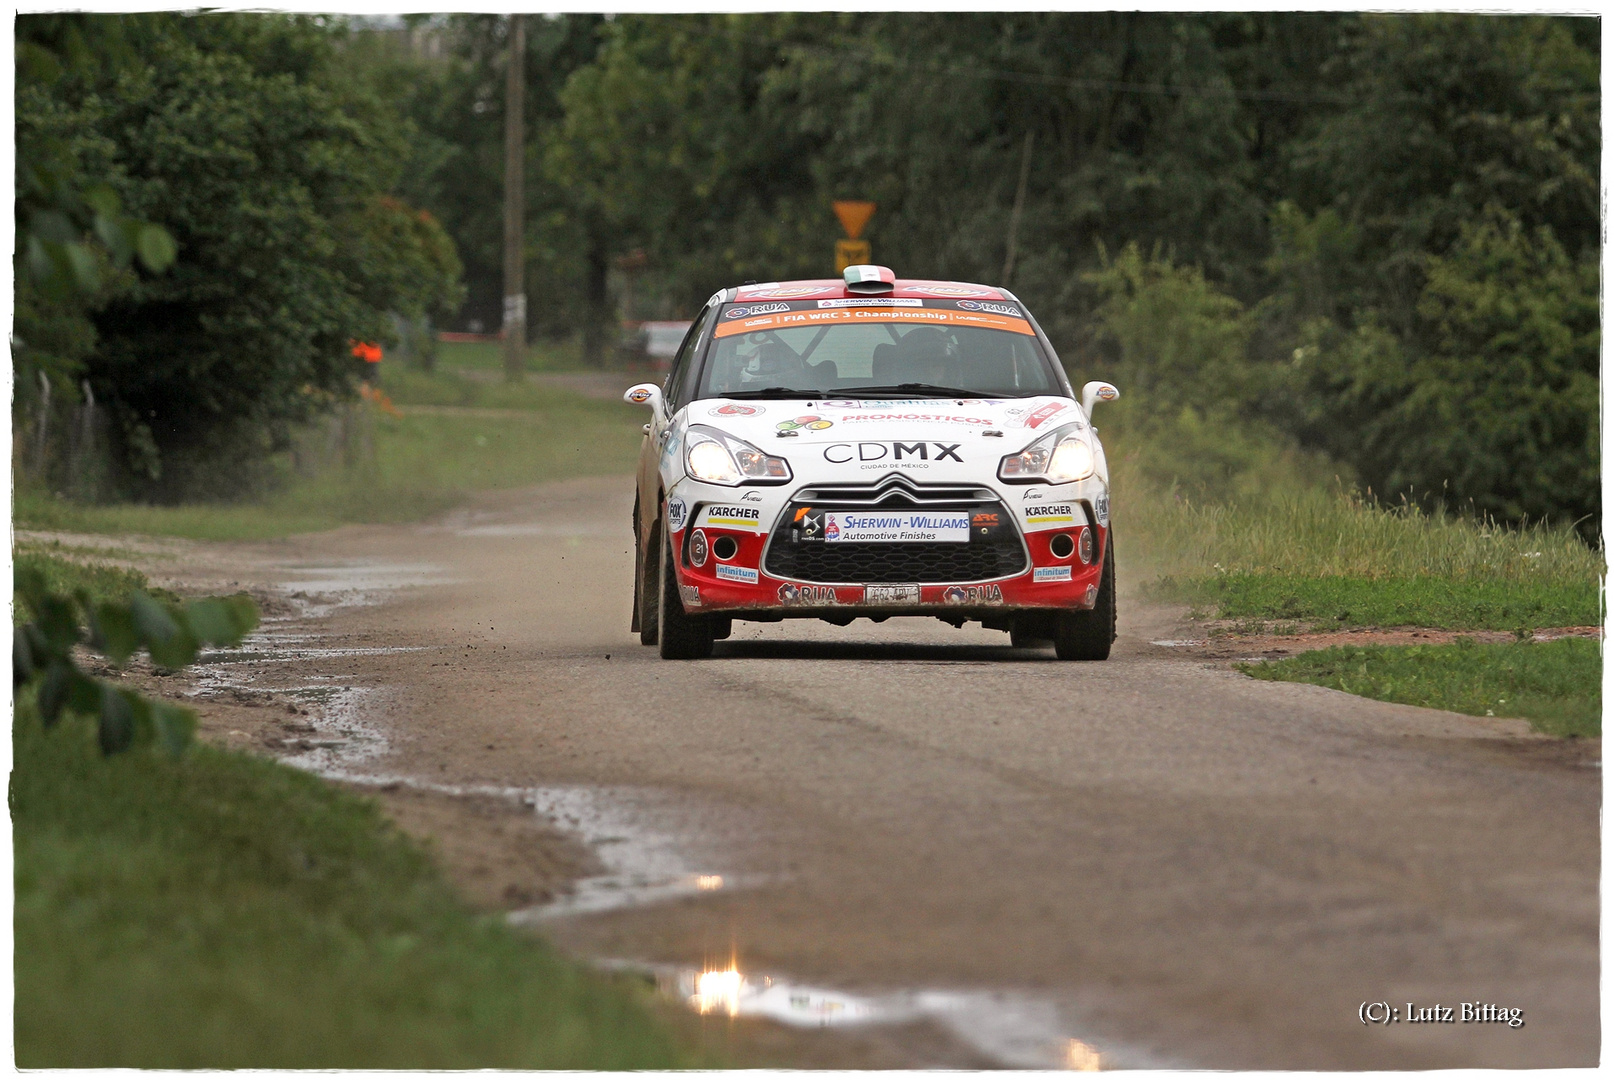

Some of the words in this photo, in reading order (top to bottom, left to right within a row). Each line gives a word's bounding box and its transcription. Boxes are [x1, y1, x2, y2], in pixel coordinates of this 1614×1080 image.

[751, 302, 790, 315] RUA
[982, 302, 1022, 317] RUA
[809, 312, 839, 320] WRC
[855, 311, 947, 320] Championship
[842, 412, 993, 426] PRONÓSTICOS
[823, 442, 965, 464] CDMX
[669, 503, 682, 518] FOX
[708, 506, 760, 519] KÄRCHER
[1025, 505, 1072, 516] KÄRCHER
[972, 513, 999, 522] ARC
[843, 531, 897, 540] Automotive
[899, 531, 936, 540] Finishes
[695, 543, 704, 554] 21
[716, 564, 757, 578] infinitum
[1034, 567, 1070, 577] infinitum
[800, 586, 837, 601] RUA
[966, 584, 1002, 601] RUA
